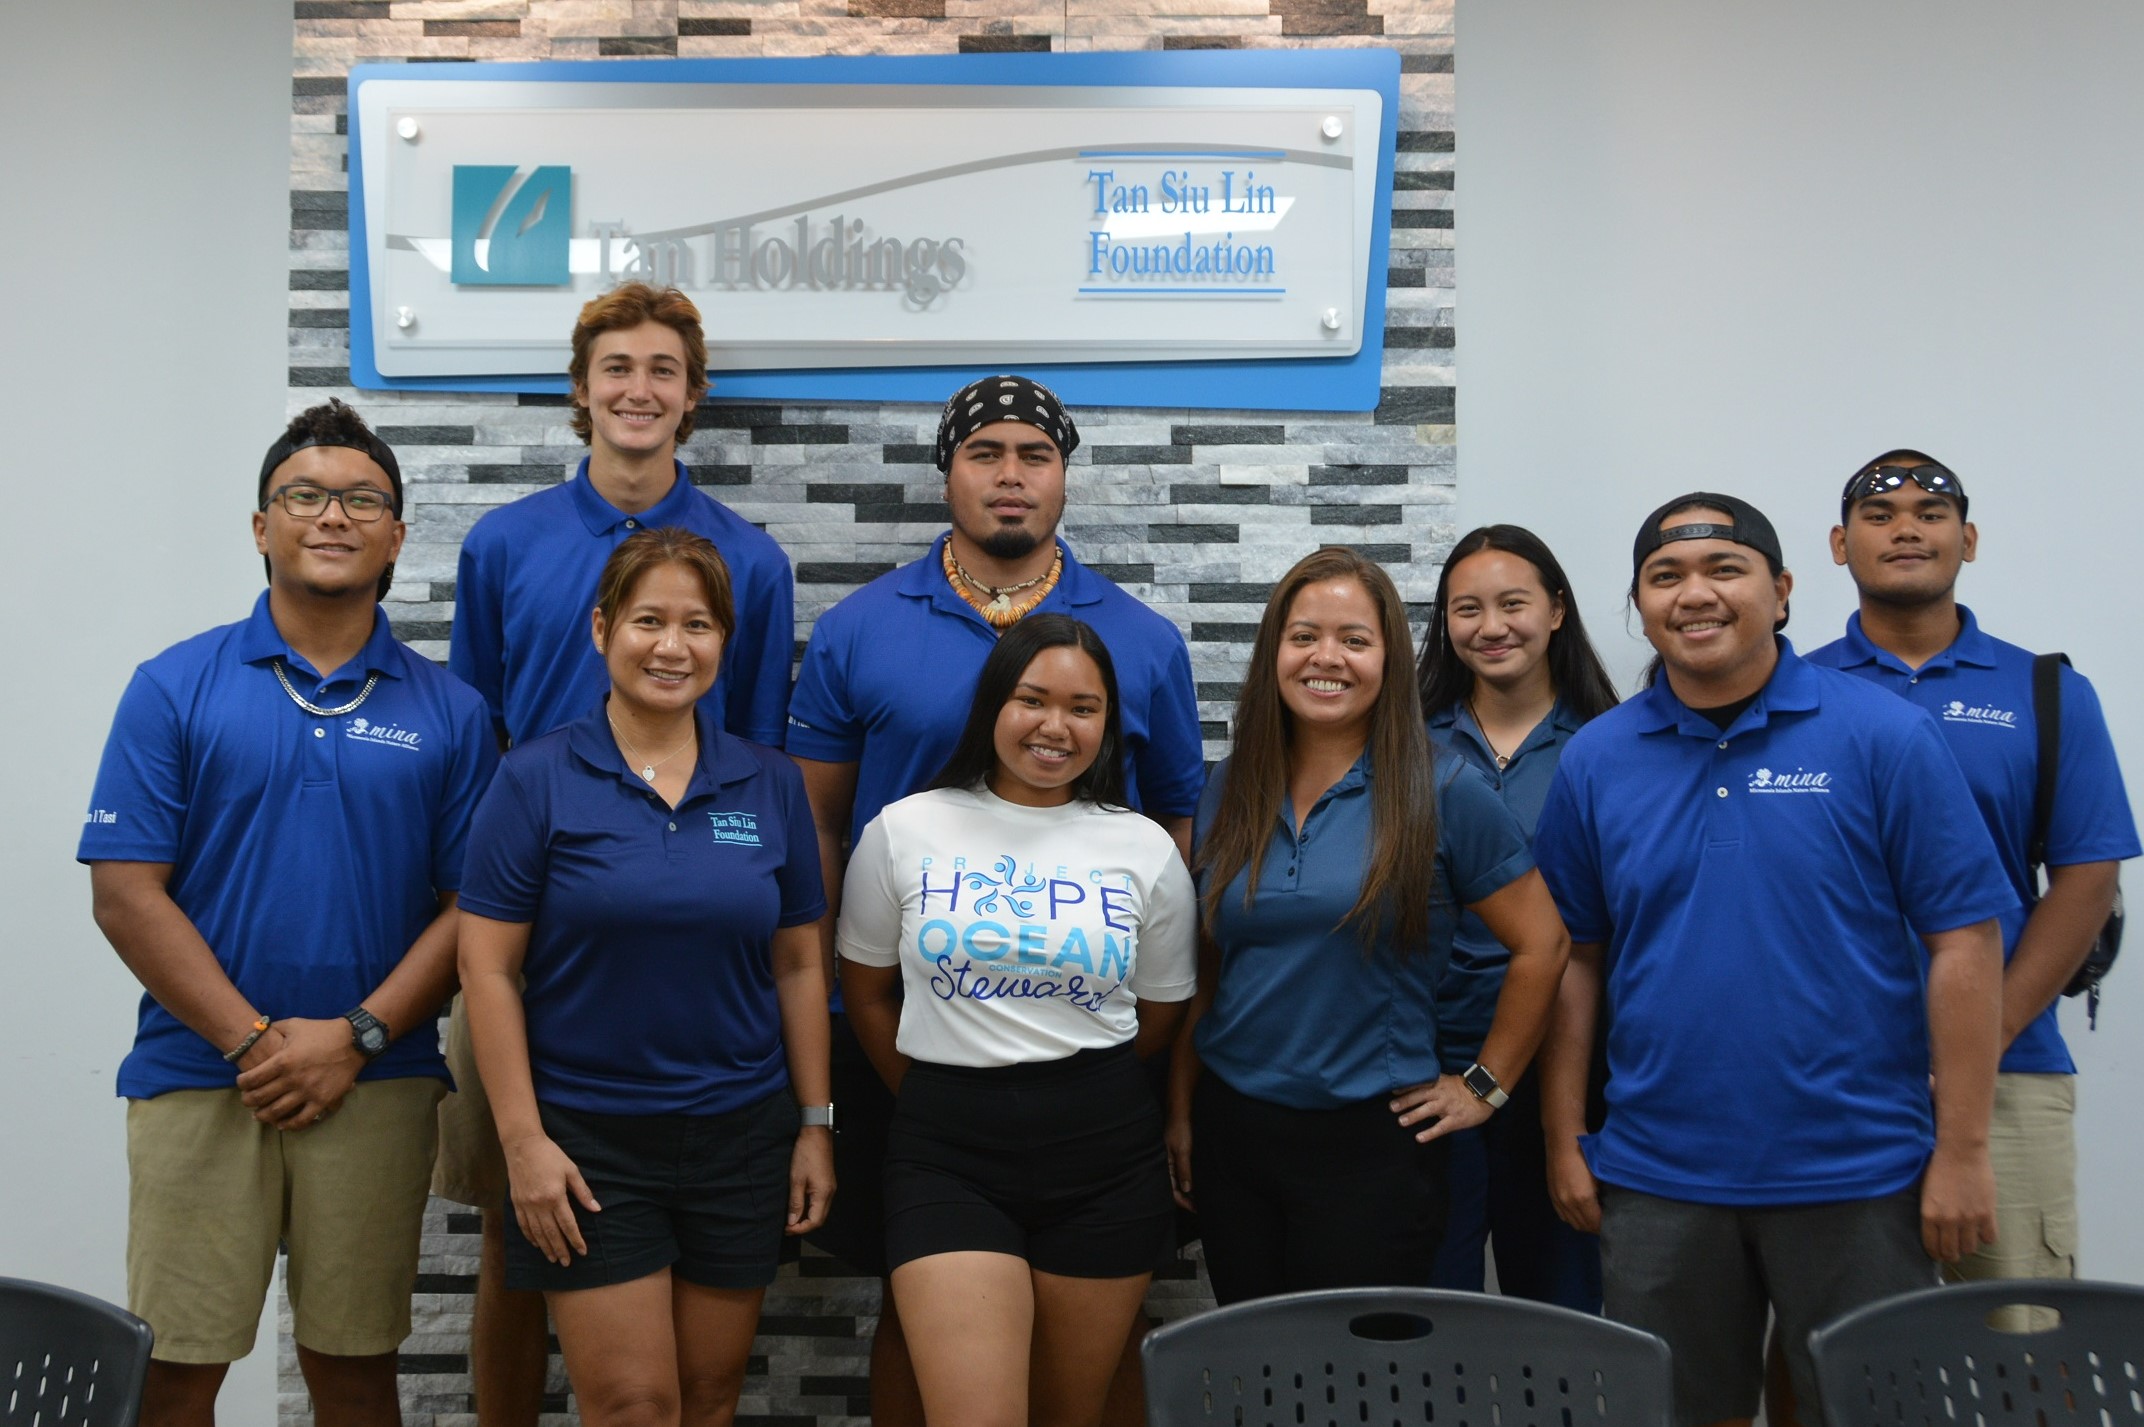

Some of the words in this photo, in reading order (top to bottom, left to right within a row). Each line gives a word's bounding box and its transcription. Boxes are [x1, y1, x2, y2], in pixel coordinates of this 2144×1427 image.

[1088, 169, 1149, 214] Tan
[1160, 169, 1211, 214] Siu
[1221, 170, 1276, 214] Lin
[588, 217, 692, 284] Tan
[709, 214, 966, 304] Holdings
[1089, 231, 1275, 274] Foundation
[1966, 704, 2017, 723] mina
[368, 723, 422, 744] mina
[1773, 767, 1832, 788] mina
[98, 809, 118, 823] Tasi
[710, 816, 728, 827] Tan
[728, 816, 742, 828] Siu
[742, 817, 757, 829] Lin
[713, 829, 760, 842] Foundation
[918, 919, 1131, 981] OCEAN
[988, 963, 1063, 980] CONSERVATION
